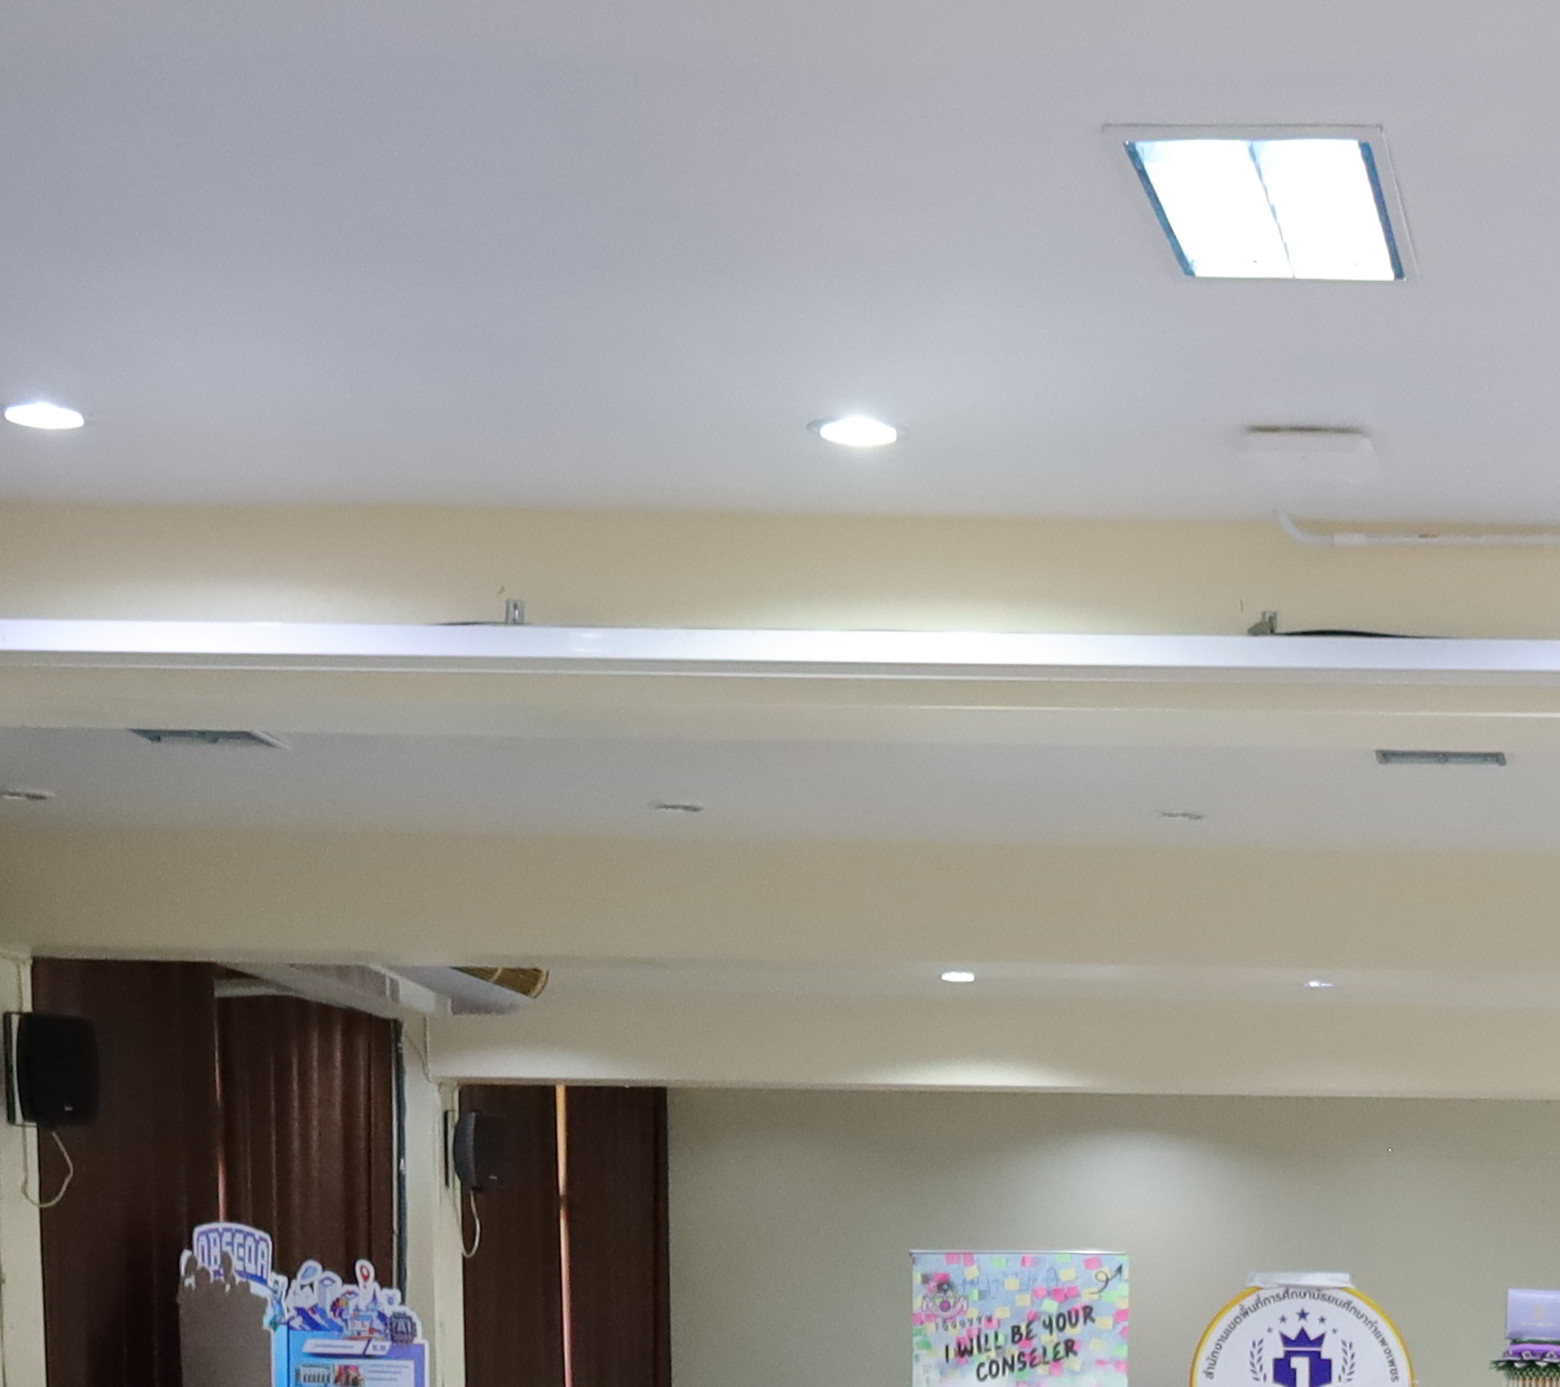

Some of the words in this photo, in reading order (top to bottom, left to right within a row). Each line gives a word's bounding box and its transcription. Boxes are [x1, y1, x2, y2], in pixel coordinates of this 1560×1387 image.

[956, 1331, 999, 1357] WILL
[1011, 1320, 1038, 1345] BE
[1042, 1305, 1095, 1335] YOUR
[976, 1338, 1077, 1381] CONSELER
